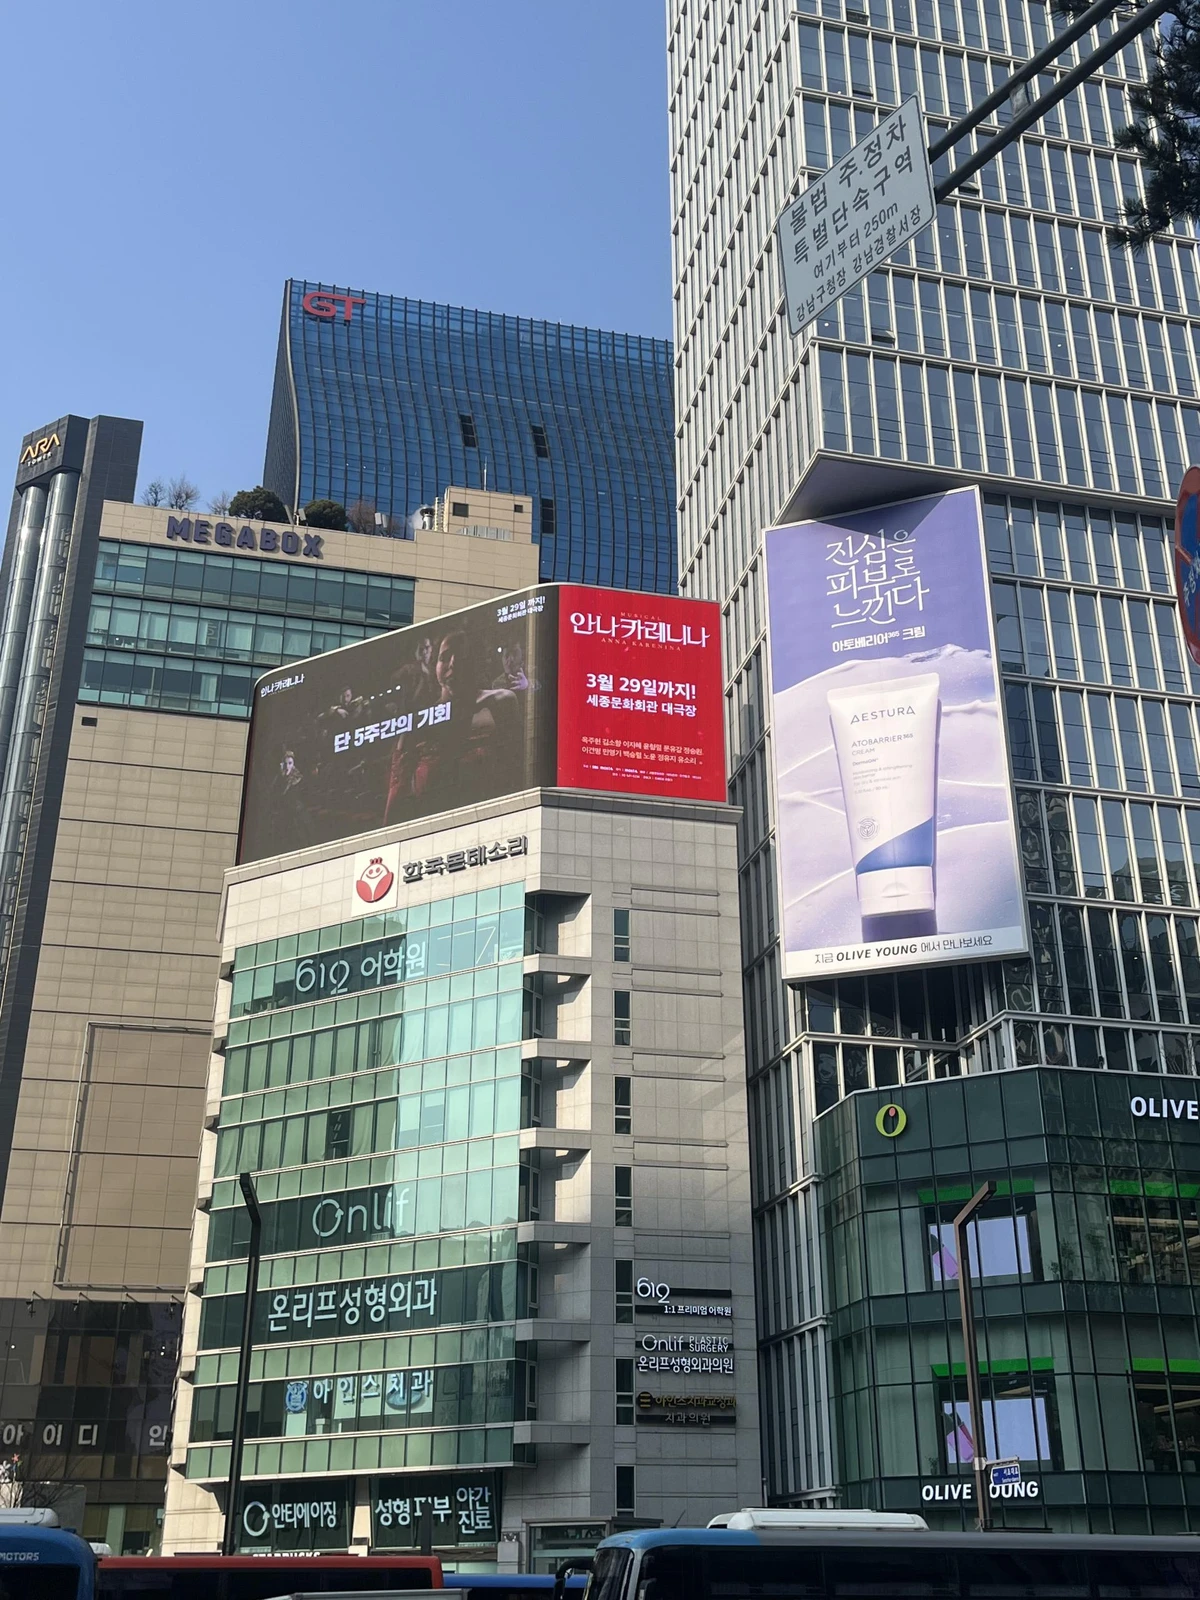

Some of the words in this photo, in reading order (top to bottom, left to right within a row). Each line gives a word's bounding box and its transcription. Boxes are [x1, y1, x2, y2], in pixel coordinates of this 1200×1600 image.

[789, 182, 828, 236] 불법
[793, 145, 913, 265] 특별단속구역
[813, 231, 860, 280] 여기부터
[863, 201, 899, 241] 250m
[796, 266, 847, 323] 강남구청장
[852, 204, 922, 275] 강남경찰서장
[302, 291, 367, 322] GT
[166, 516, 326, 558] MEGABOX
[825, 529, 917, 566] 진심은
[826, 556, 921, 601] 피부로
[510, 600, 526, 613] 29일
[620, 611, 661, 621] MUSICAL
[831, 576, 930, 628] 느낀다
[601, 637, 627, 646] ANNA
[631, 641, 681, 651] KARENINA
[902, 625, 926, 640] 크림
[586, 673, 614, 692] 3월
[619, 676, 697, 700] 29일까지!
[586, 694, 658, 714] 세종문화회관
[661, 699, 697, 717] 대극장
[850, 705, 916, 725] AESTURA
[333, 731, 352, 754] 단
[354, 712, 413, 747] 5주간의
[417, 701, 452, 729] 기회
[851, 747, 876, 756] CREAM
[402, 835, 529, 884] 한국몬테소리
[360, 941, 426, 985] 어학원
[814, 952, 835, 965] 지금
[836, 948, 871, 962] OLIVE
[875, 943, 918, 958] YOUNG
[920, 941, 941, 953] 에서
[942, 935, 993, 950] 만나보세요
[1130, 1096, 1200, 1120] OLIVE
[312, 1188, 410, 1237] Onlif
[268, 1277, 437, 1332] 온리프성형외과
[663, 1305, 676, 1314] 1:1
[677, 1305, 708, 1315] 프리미엄
[708, 1306, 732, 1317] 어학원
[642, 1334, 684, 1352] Onlif
[689, 1335, 729, 1345] PLASTIC
[689, 1344, 729, 1353] SURGERY
[637, 1356, 734, 1374] 온리프성형외과의원
[313, 1370, 433, 1405] 아인스치과
[456, 1486, 492, 1510] 야간
[921, 1484, 972, 1501] OLIVE
[989, 1481, 1039, 1499] OUNG
[271, 1501, 337, 1529] 안티에이징
[374, 1498, 411, 1527] 성형
[458, 1510, 493, 1534] 진료
